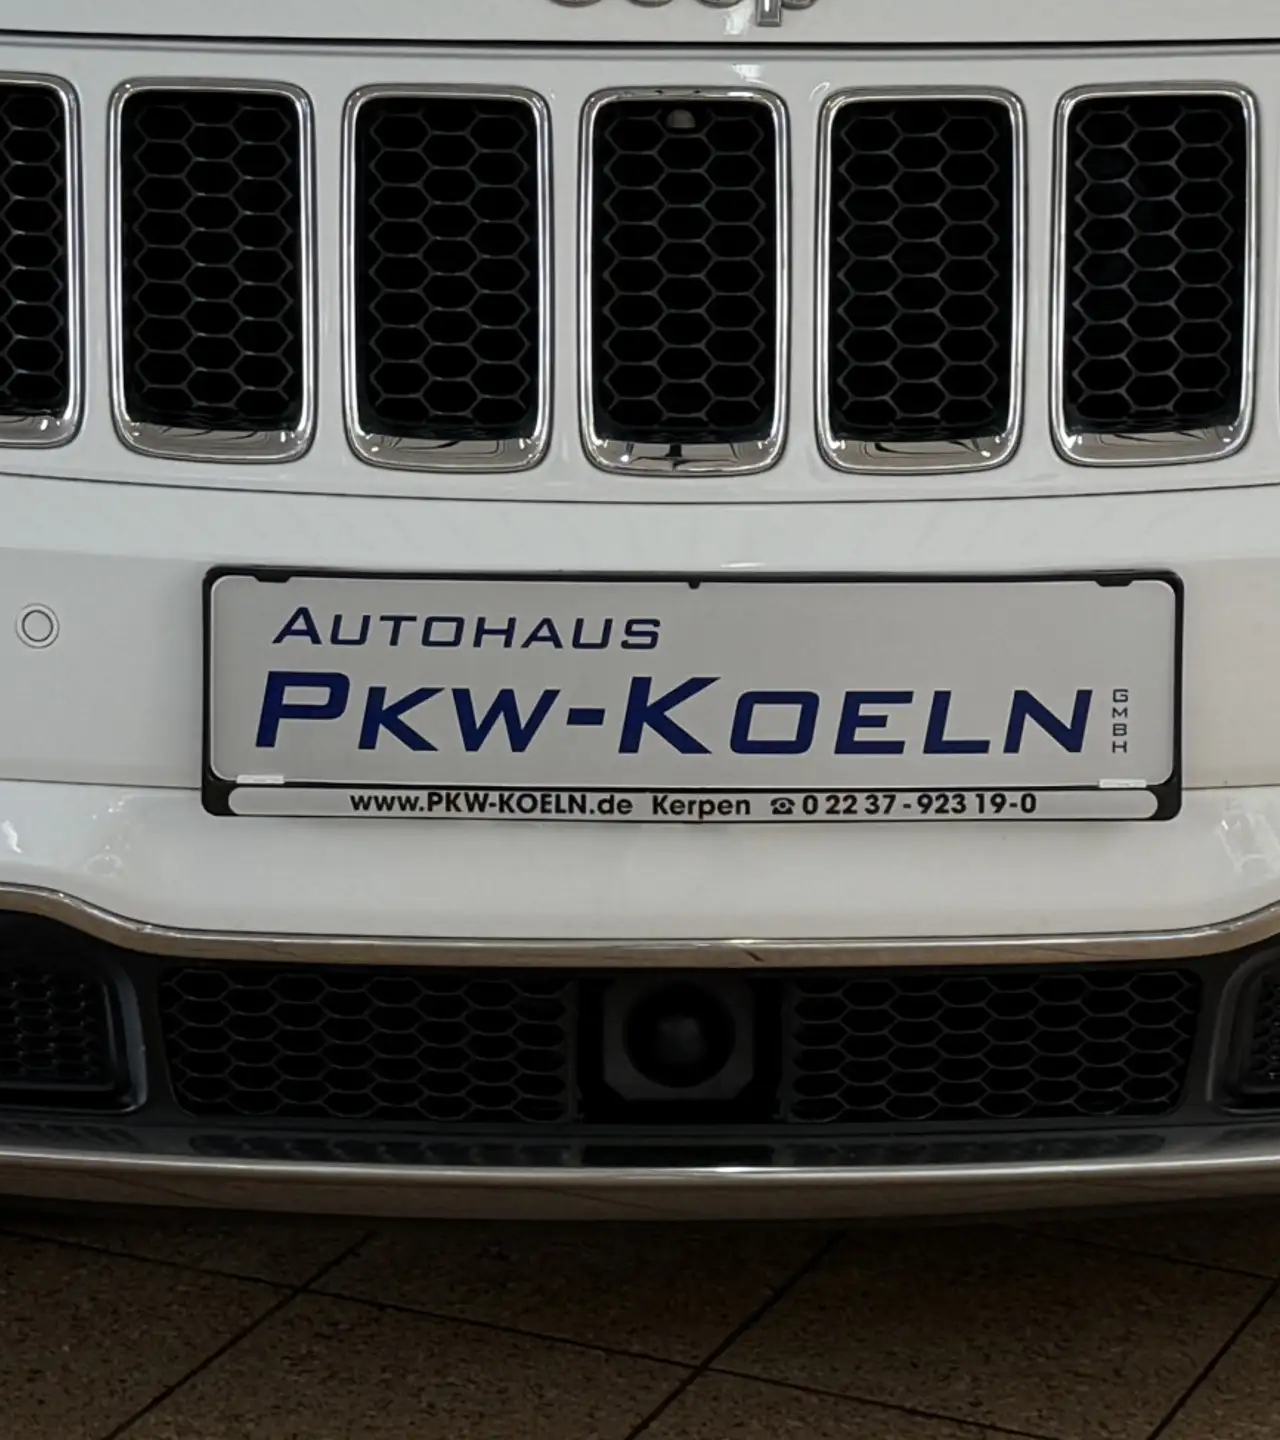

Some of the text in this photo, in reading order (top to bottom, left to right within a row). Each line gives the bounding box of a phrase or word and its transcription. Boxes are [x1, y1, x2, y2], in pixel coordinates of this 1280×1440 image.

[272, 606, 661, 650] AUTOHAUS
[255, 670, 1093, 755] PKW-KOELN
[349, 791, 634, 816] www.PKW-KOELN.de
[652, 794, 751, 820] Kerpen
